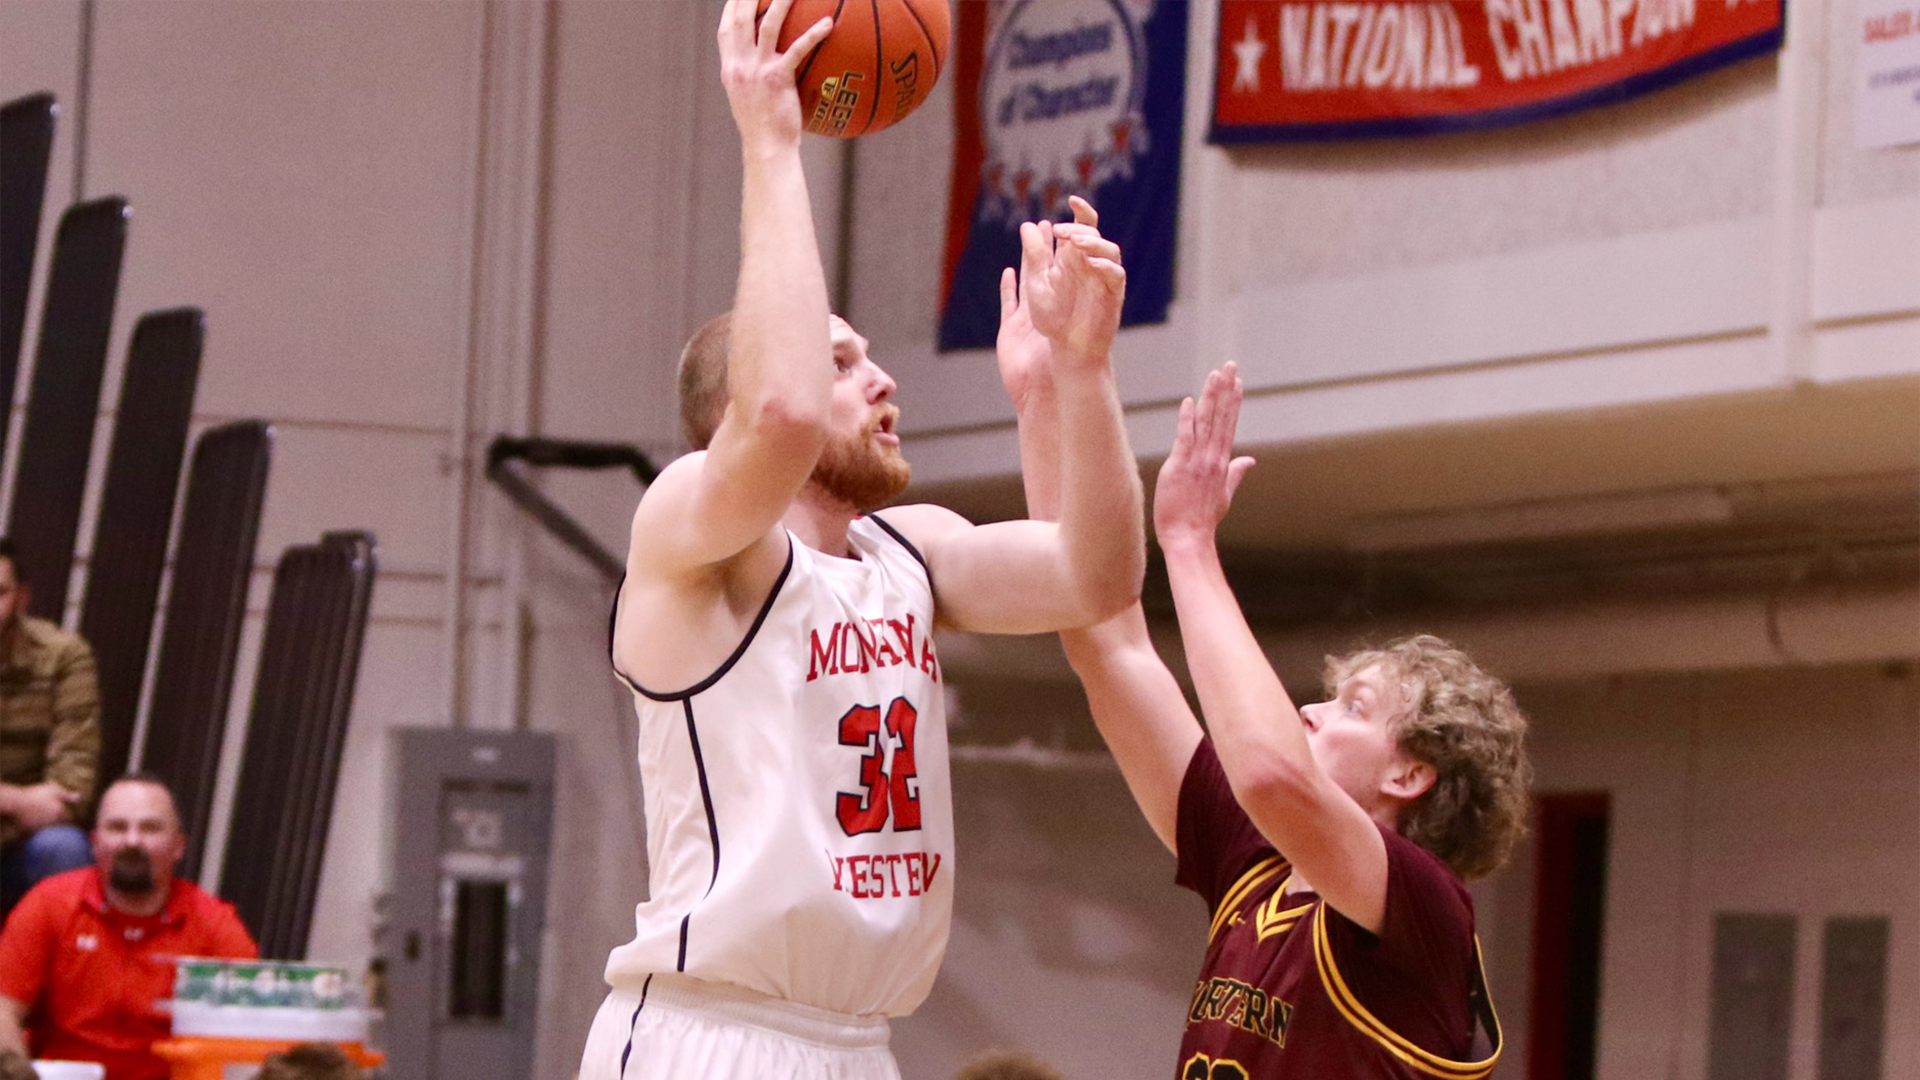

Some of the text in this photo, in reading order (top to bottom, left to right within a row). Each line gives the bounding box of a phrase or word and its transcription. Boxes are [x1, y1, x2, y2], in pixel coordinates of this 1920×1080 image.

[1280, 3, 1481, 89] NATIONAL
[835, 695, 922, 838] 32
[825, 849, 942, 899] ESTEN
